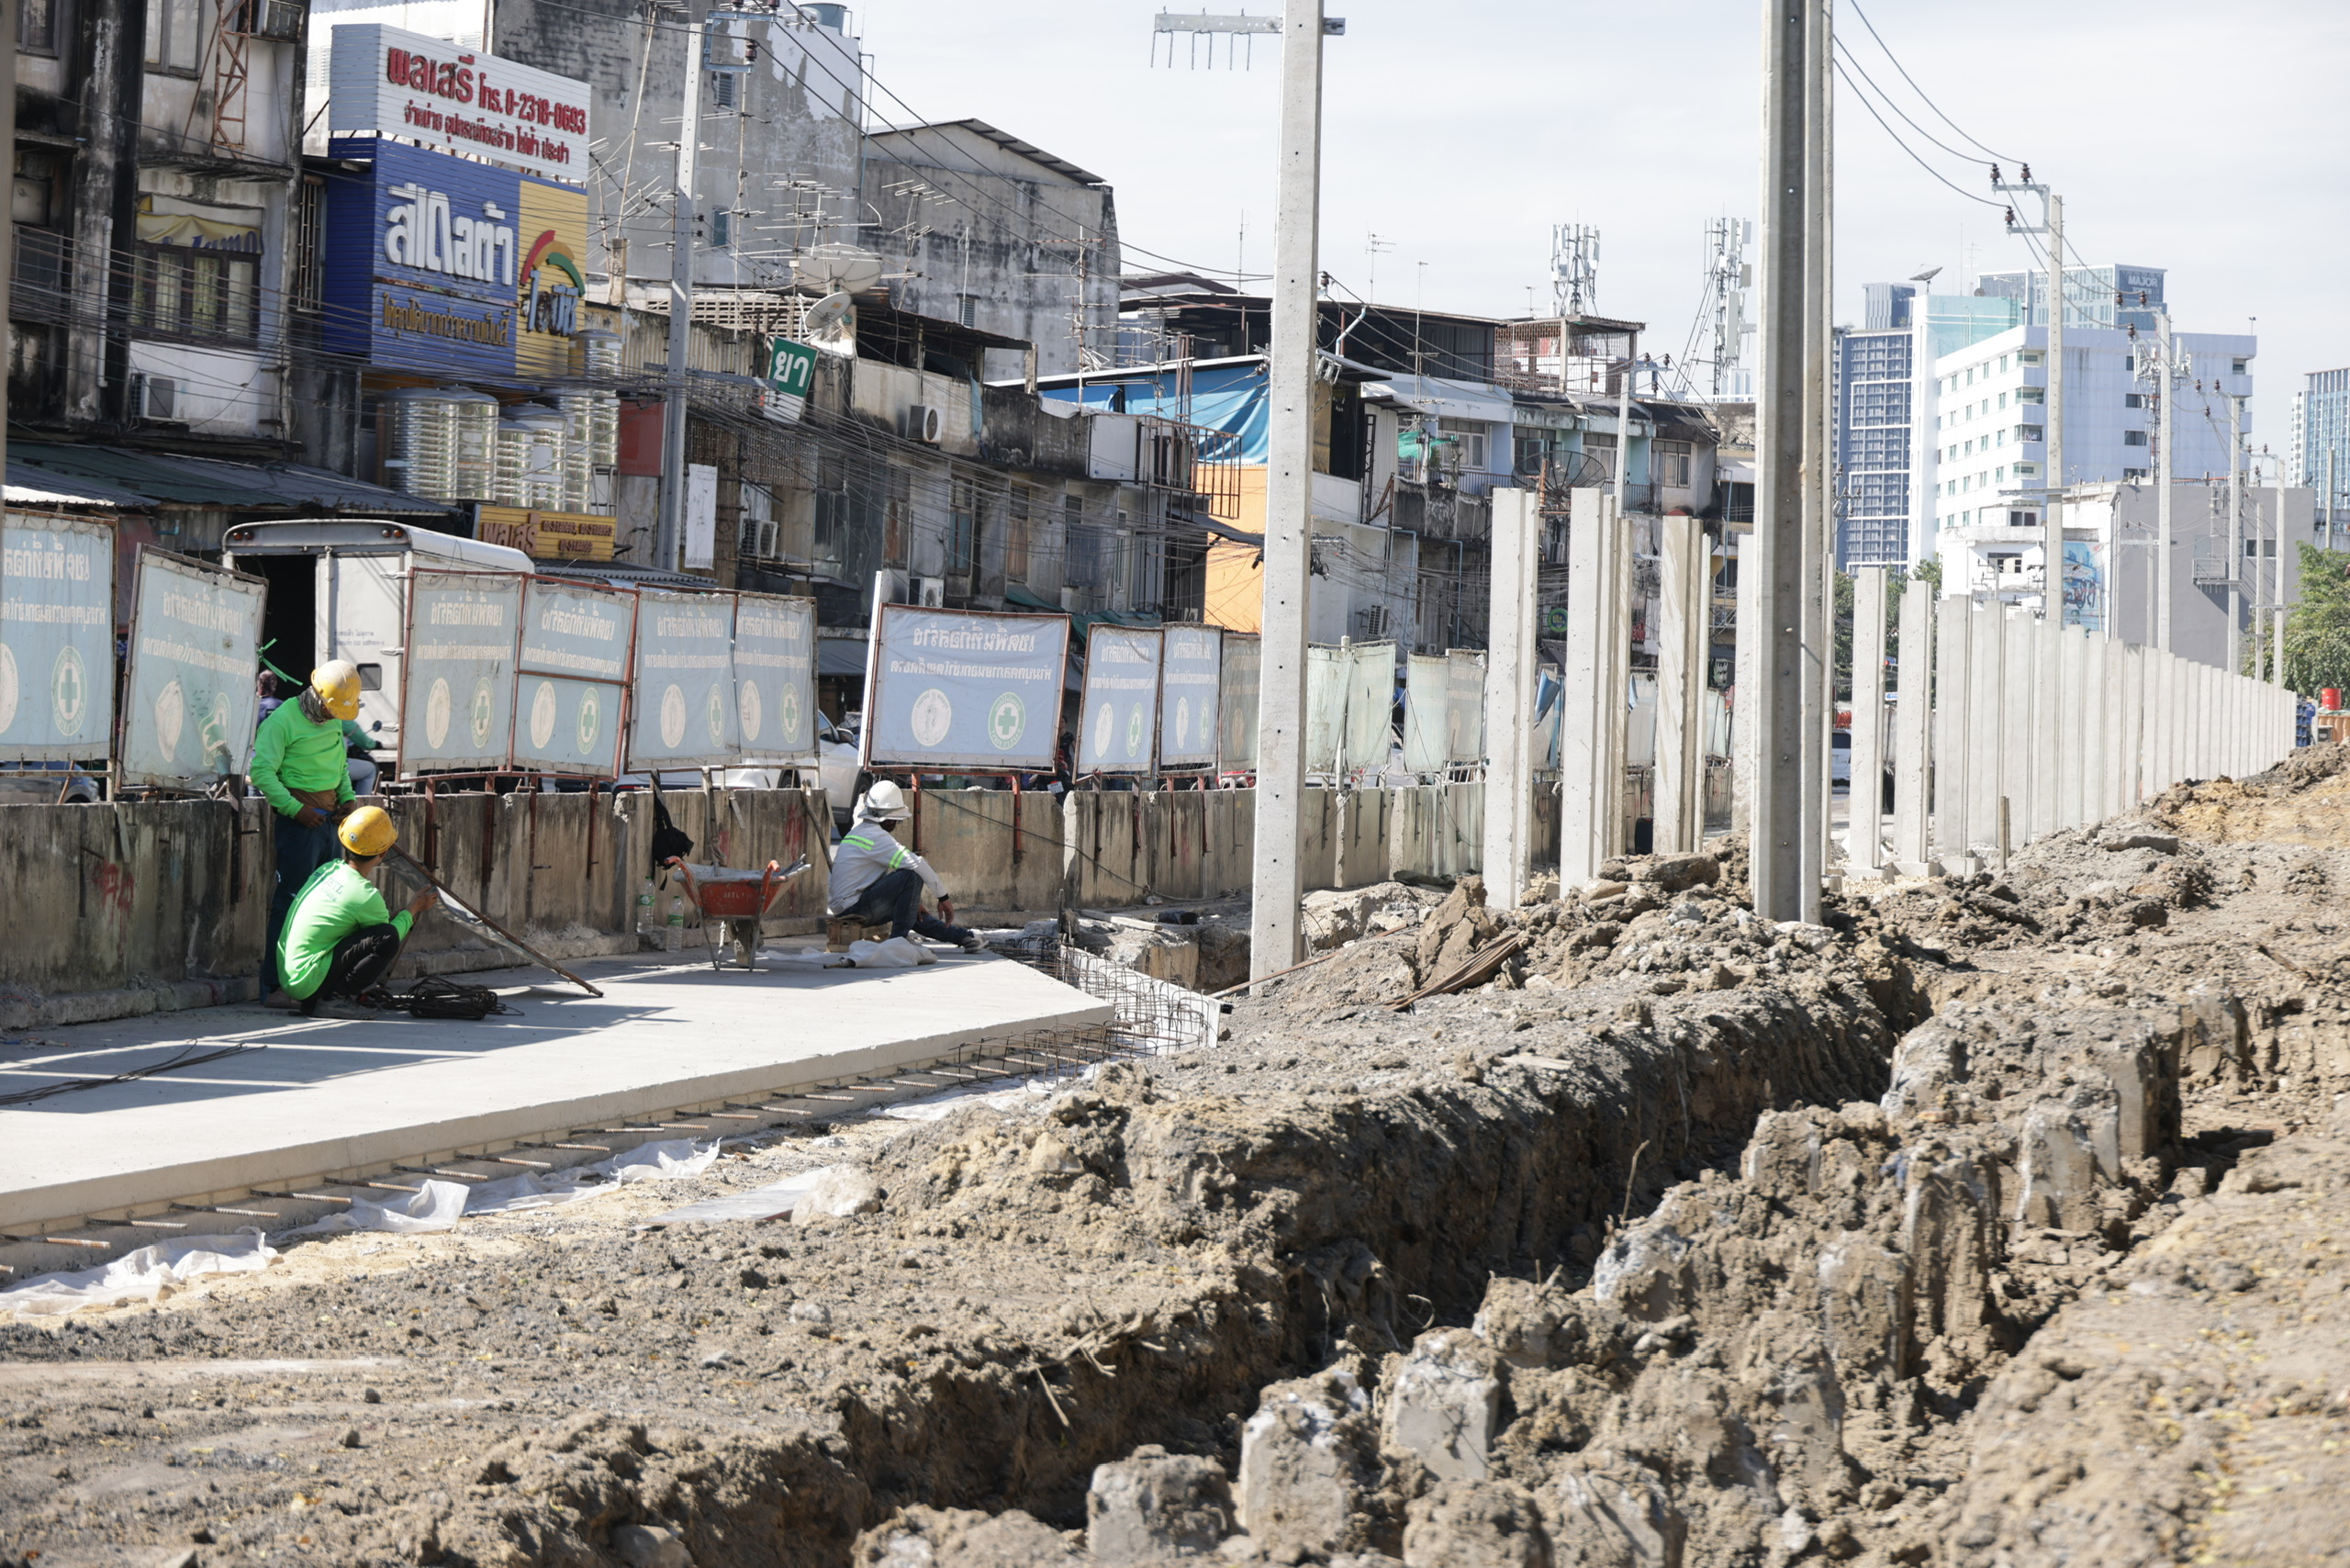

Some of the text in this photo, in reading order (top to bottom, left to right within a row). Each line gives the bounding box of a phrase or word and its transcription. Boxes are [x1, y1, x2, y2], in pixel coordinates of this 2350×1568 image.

[479, 72, 504, 113] โทร.
[506, 88, 587, 135] 0-2318-0693
[404, 99, 442, 131] จำหน่าย
[516, 125, 540, 158] ไฟฟ้า
[542, 137, 570, 164] ประปา
[2128, 274, 2158, 287] MAJOR
[773, 351, 810, 387] ยา
